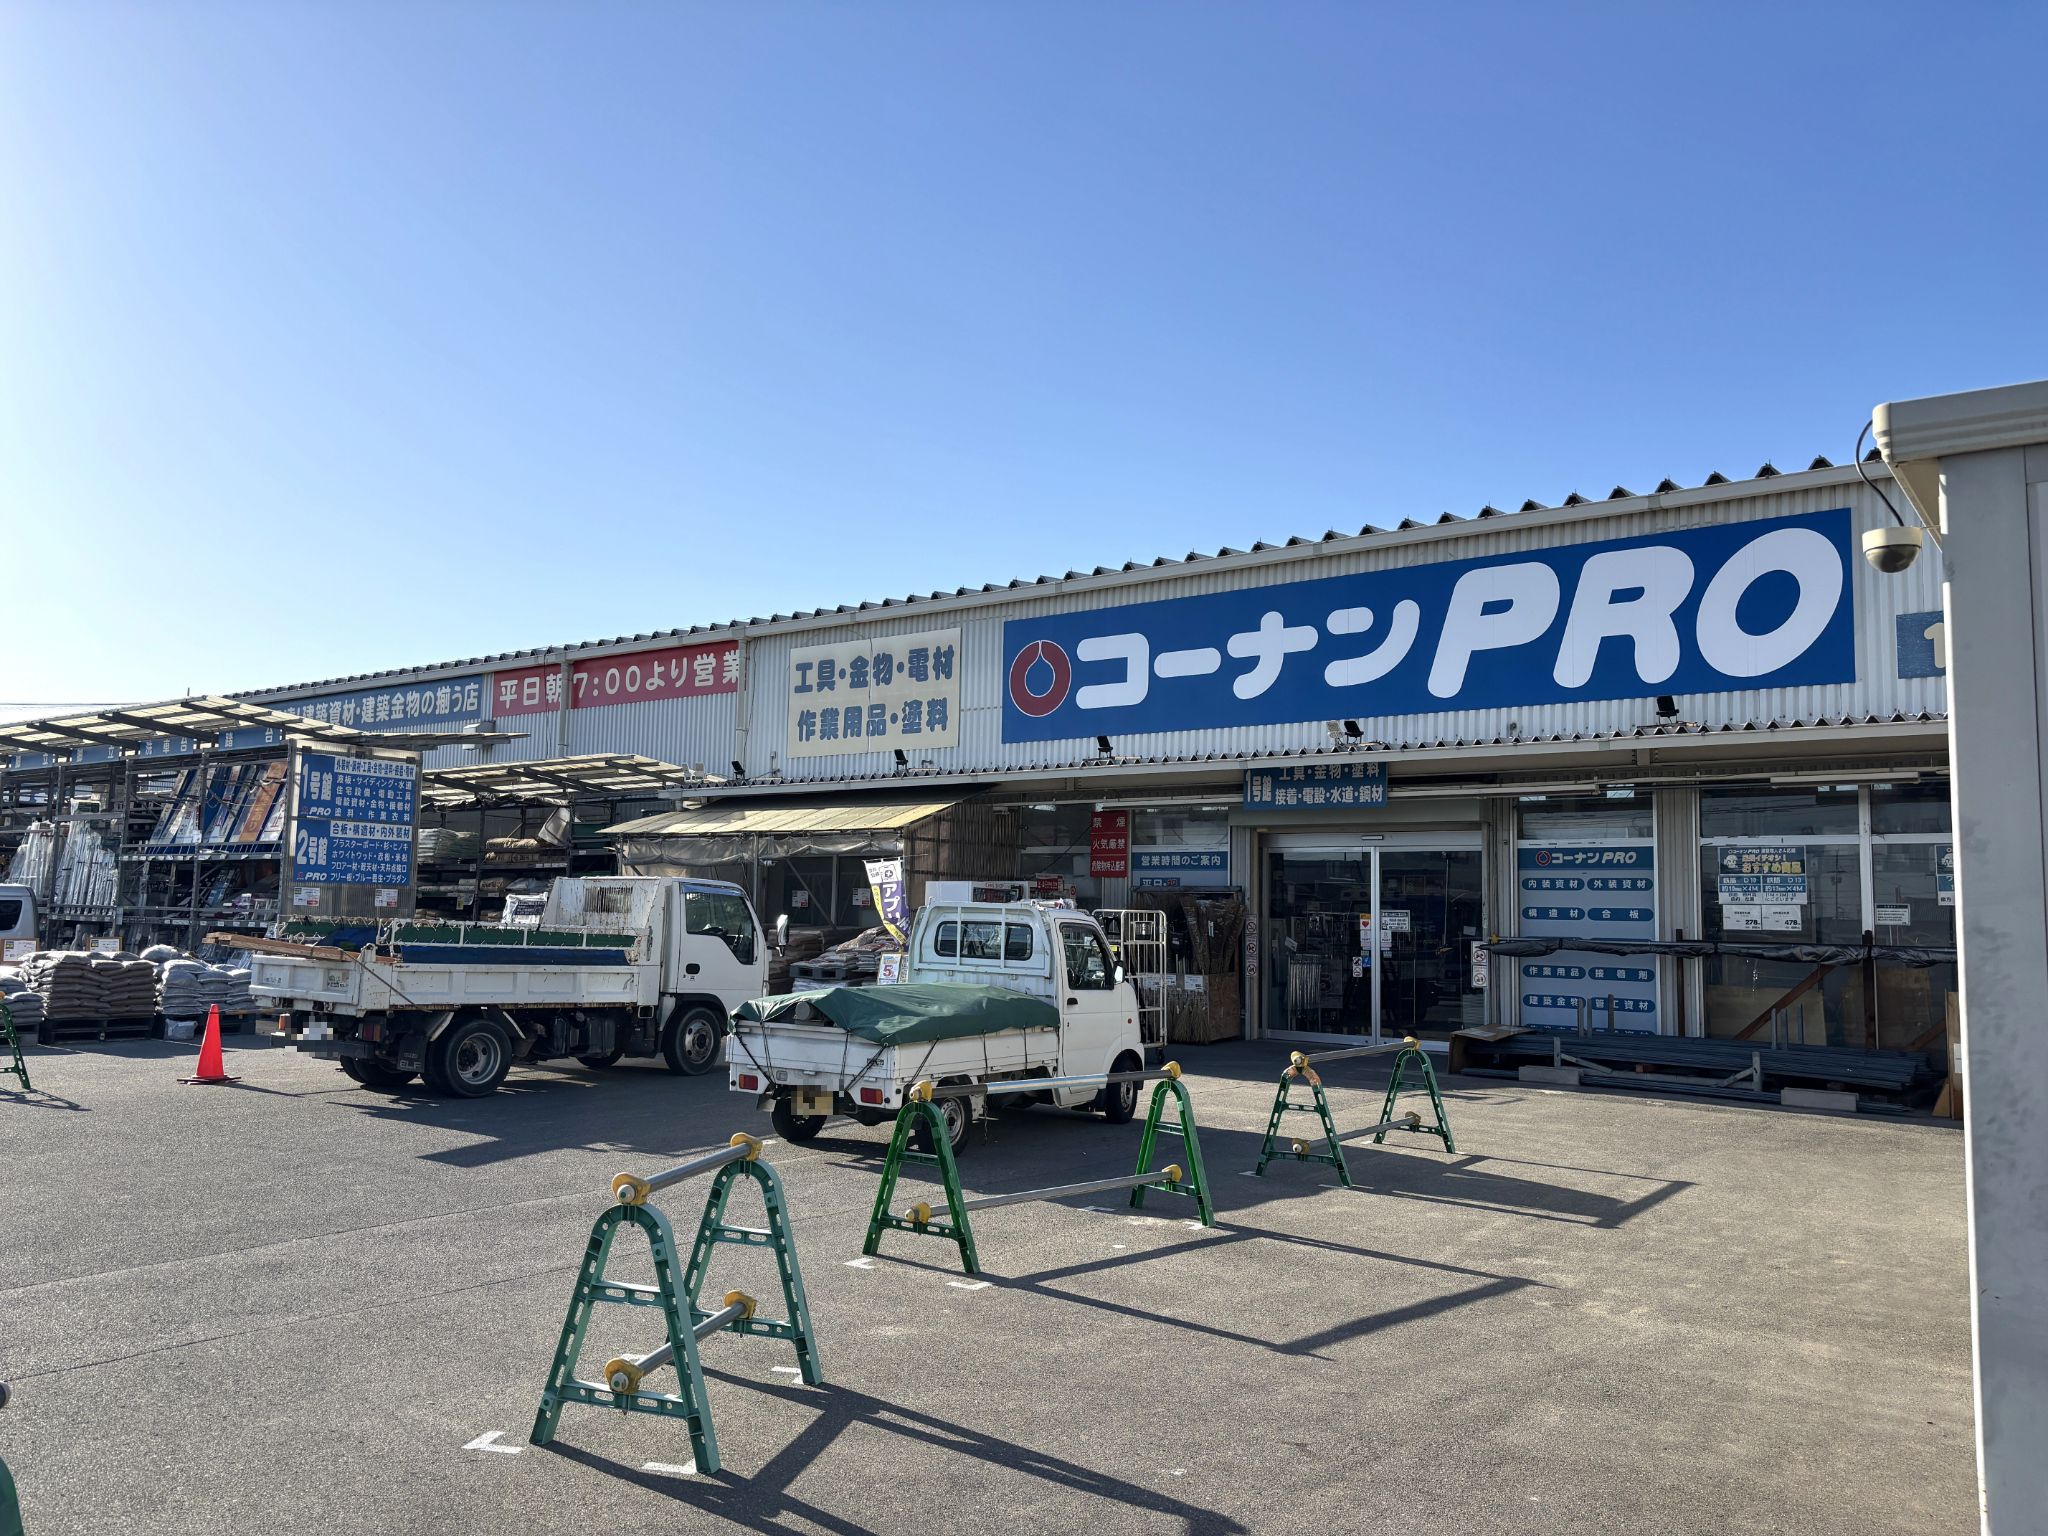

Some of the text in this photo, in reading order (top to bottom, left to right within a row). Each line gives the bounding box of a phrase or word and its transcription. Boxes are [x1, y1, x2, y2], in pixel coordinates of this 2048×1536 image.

[794, 643, 956, 694] 工具・金物・電材
[796, 696, 949, 743] 作業用品・塗料
[302, 763, 333, 801] 1号館
[1246, 769, 1272, 803] 1号館
[1275, 784, 1384, 806] 接着・電設・水道・鋼材
[309, 806, 332, 816] PRO
[332, 822, 410, 839] 合板・構造材・内外装材
[296, 828, 328, 866] 2号館
[1092, 838, 1126, 850] 火気厳禁
[1141, 855, 1221, 867] 営業時間のご案内
[1742, 861, 1802, 874] おすすめ商品
[305, 872, 327, 881] PRO
[1528, 880, 1579, 889] 内装資材
[1593, 879, 1647, 889] 外装資材
[1528, 908, 1579, 918] 構造材
[1601, 909, 1640, 919] 合板
[1528, 966, 1580, 977] 作業用品
[1528, 996, 1579, 1007] 建築金物
